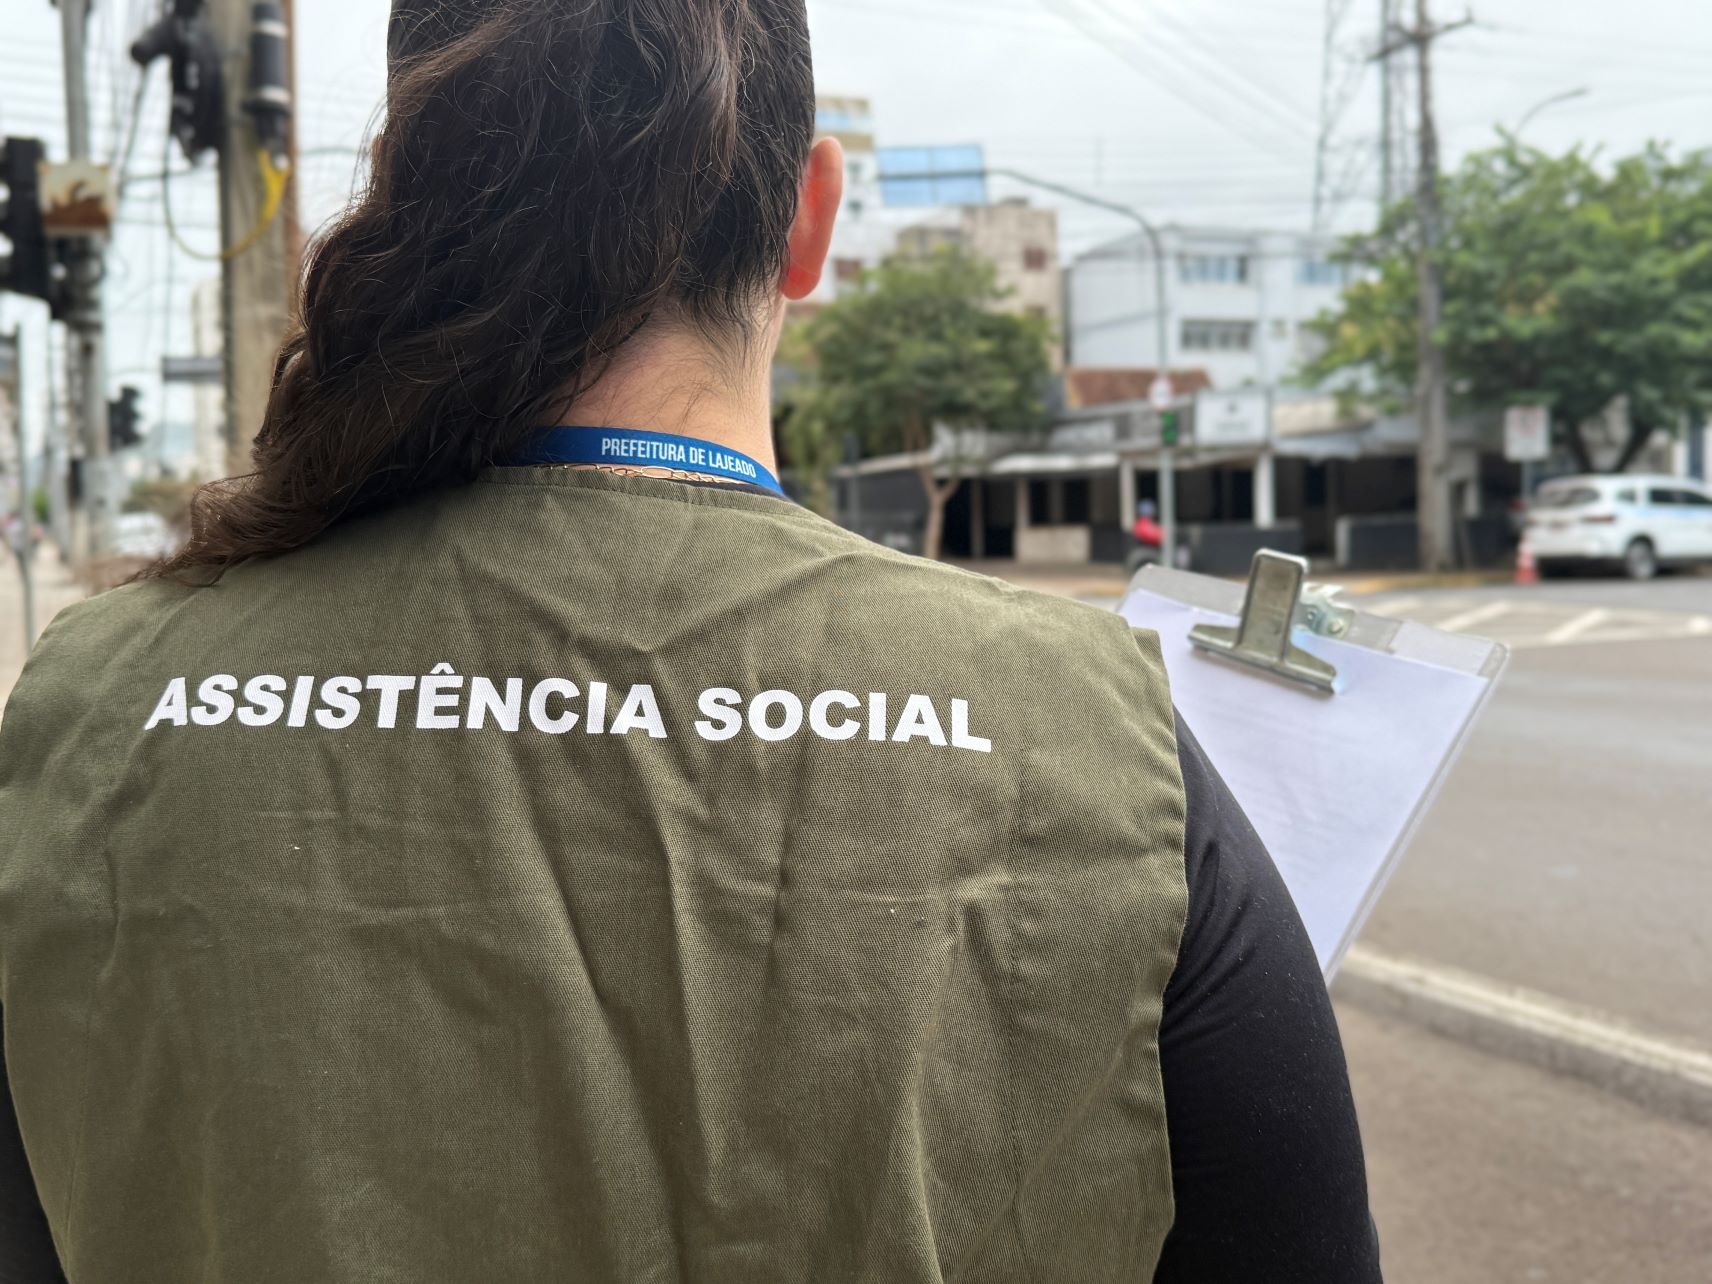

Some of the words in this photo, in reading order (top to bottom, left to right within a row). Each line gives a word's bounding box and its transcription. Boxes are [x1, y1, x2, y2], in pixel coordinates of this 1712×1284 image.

[602, 438, 686, 463] PREFEITURA
[689, 446, 706, 466] DE
[708, 452, 756, 478] LAJEADO
[144, 662, 668, 739] ASSISTÊNCIA
[693, 687, 993, 755] SOCIAL
